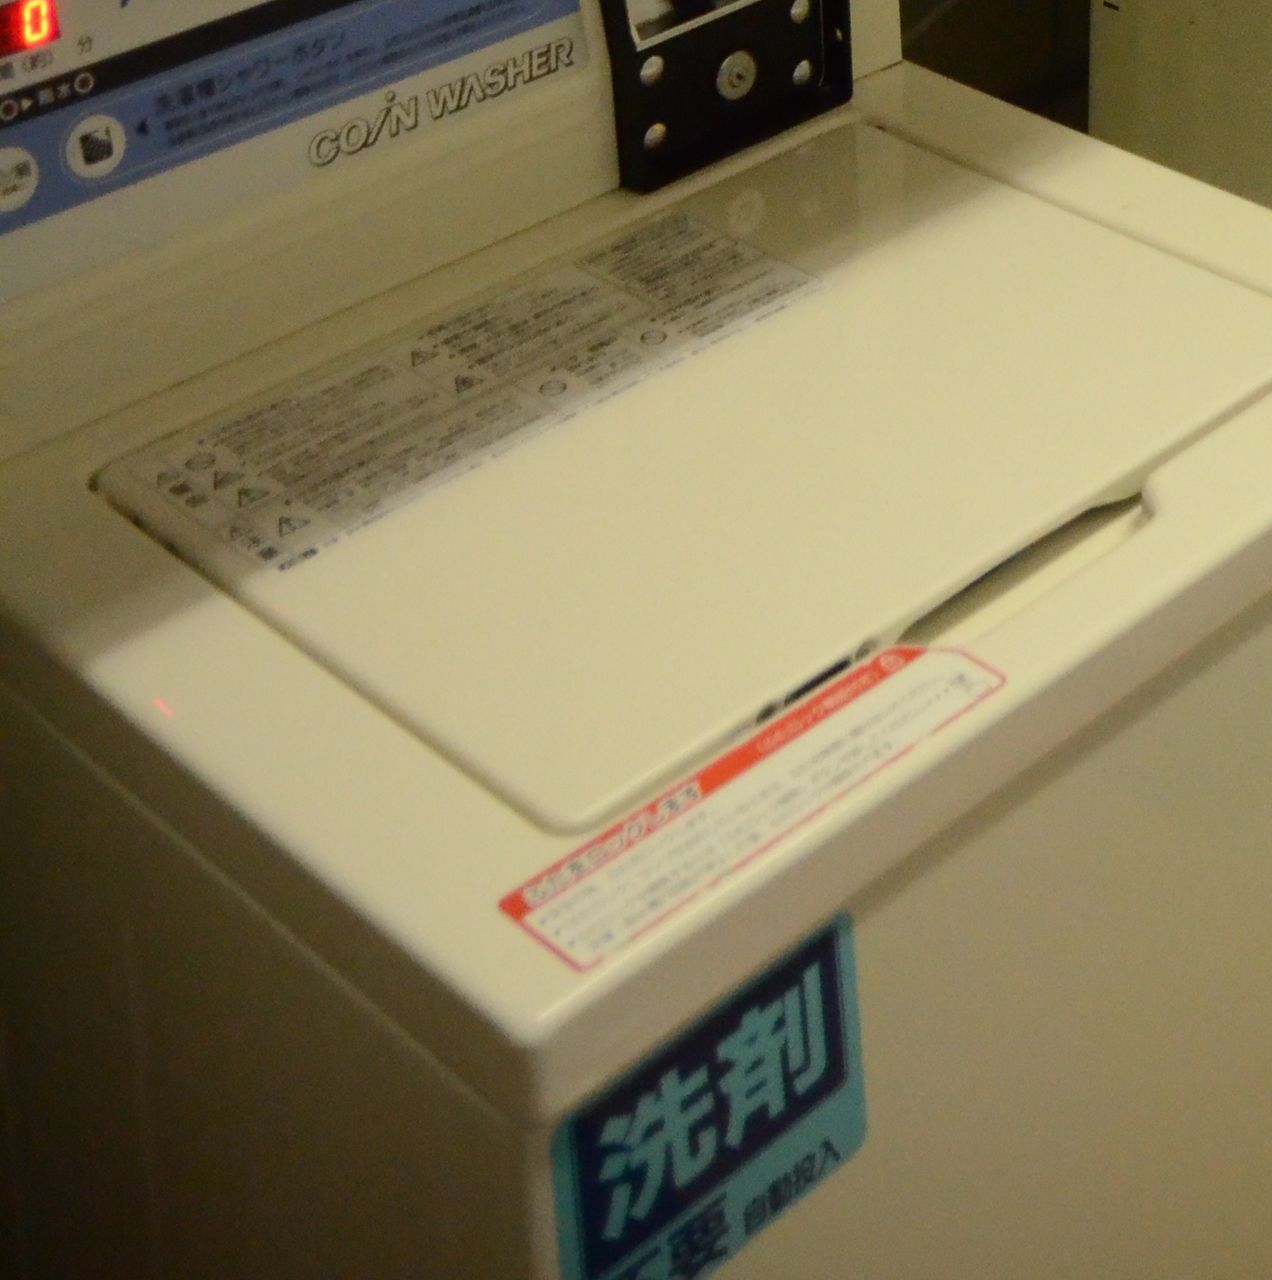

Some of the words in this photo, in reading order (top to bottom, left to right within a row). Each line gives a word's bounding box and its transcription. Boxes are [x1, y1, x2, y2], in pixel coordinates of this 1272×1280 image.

[77, 34, 93, 55] 分
[427, 37, 575, 120] WASHER
[599, 960, 829, 1242] 洗剤
